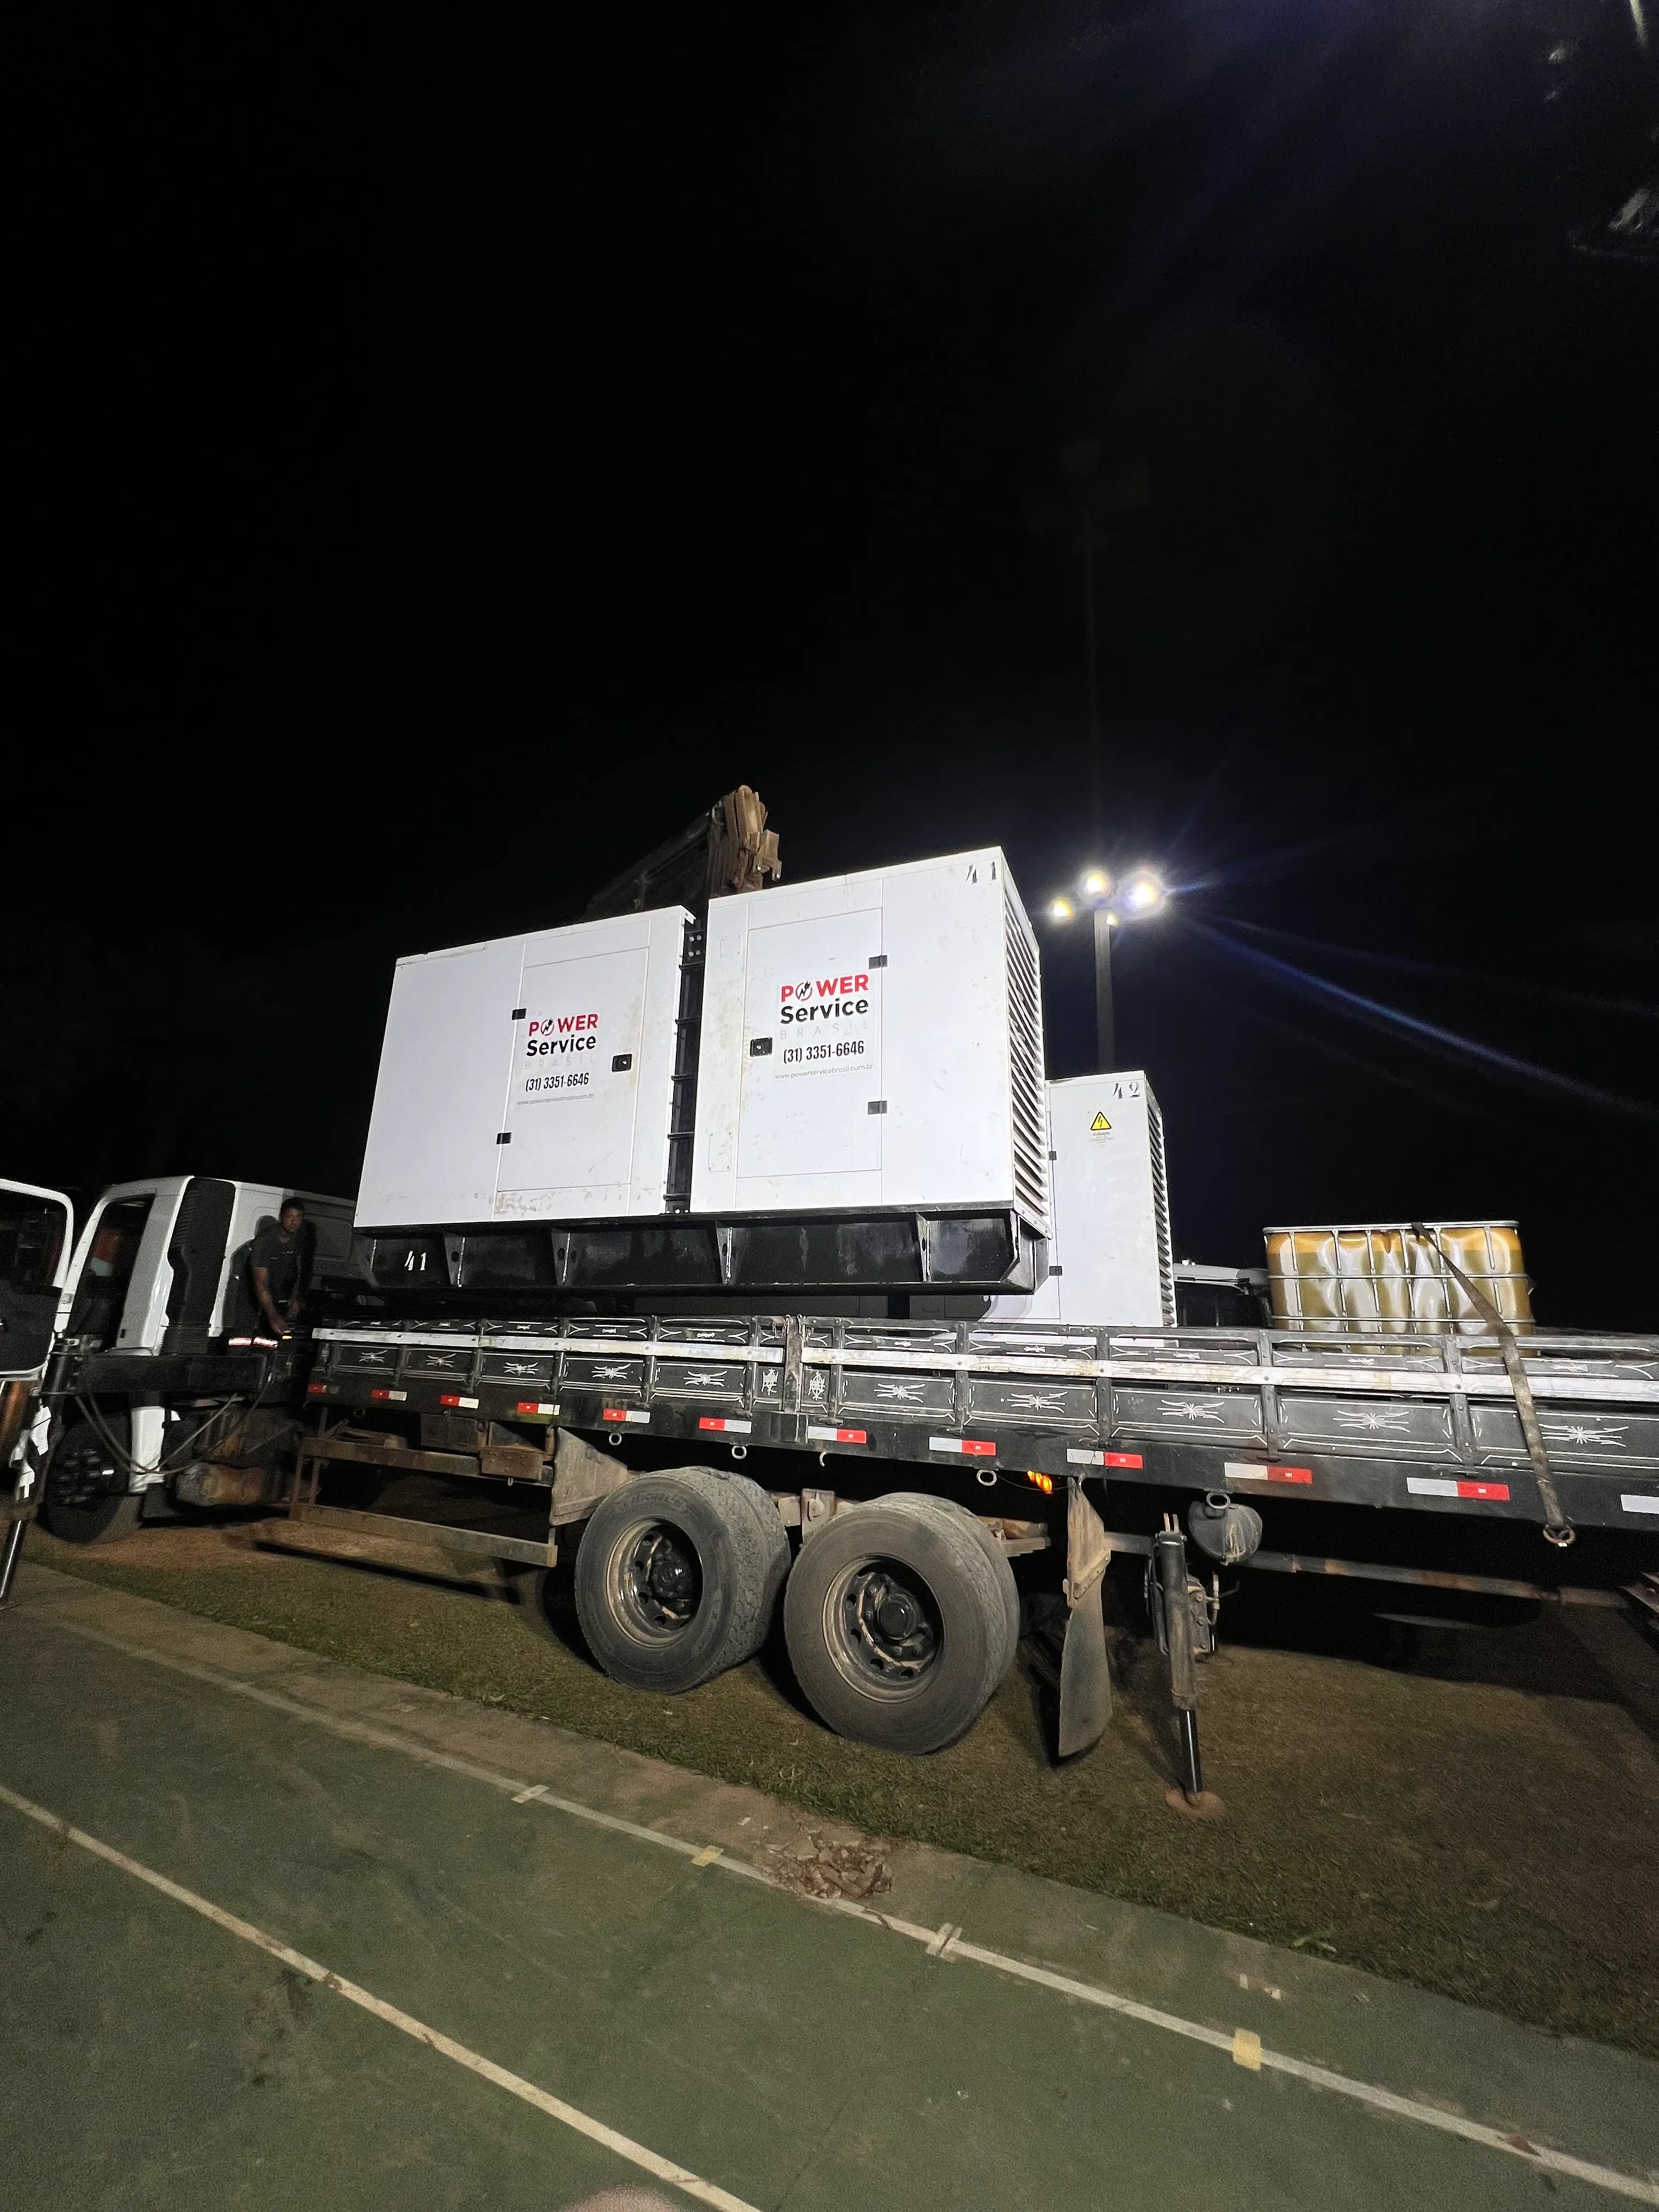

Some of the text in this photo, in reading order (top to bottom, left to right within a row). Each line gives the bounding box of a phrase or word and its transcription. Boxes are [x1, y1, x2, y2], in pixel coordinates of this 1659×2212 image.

[966, 861, 997, 884] 41
[781, 974, 869, 1003] POWER
[780, 998, 869, 1024] Service
[528, 1014, 599, 1036] POWER
[780, 1020, 868, 1040] BRASIL
[526, 1034, 596, 1057] Service
[783, 1040, 865, 1064] (31) 3351-6646
[525, 1053, 595, 1070] BRASIL
[775, 1063, 873, 1080] www.powerservicebrasil.com.br
[526, 1073, 589, 1092] (31) 3351-6646
[1113, 1081, 1140, 1099] 42
[404, 1250, 426, 1271] 41
